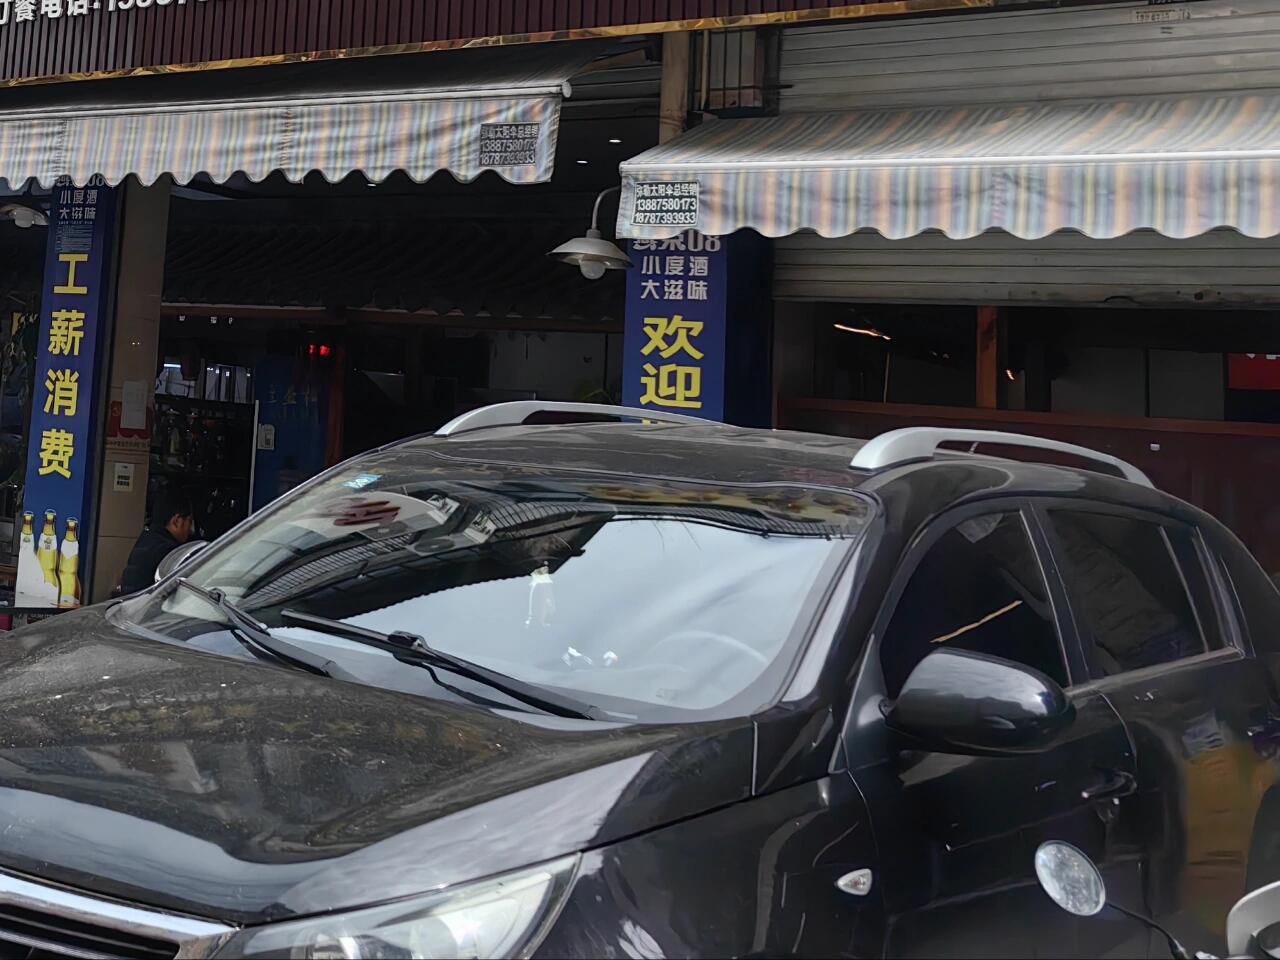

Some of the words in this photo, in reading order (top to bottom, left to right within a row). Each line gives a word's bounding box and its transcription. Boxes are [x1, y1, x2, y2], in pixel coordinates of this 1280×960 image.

[60, 189, 98, 205] 小度酒
[636, 198, 697, 211] 13887580173
[59, 207, 97, 220] 大滋味
[634, 211, 697, 224] 18787393933
[641, 255, 709, 276] 小度酒
[640, 279, 709, 300] 大滋味
[37, 253, 88, 480] 工薪消费
[640, 314, 704, 409] 欢迎
